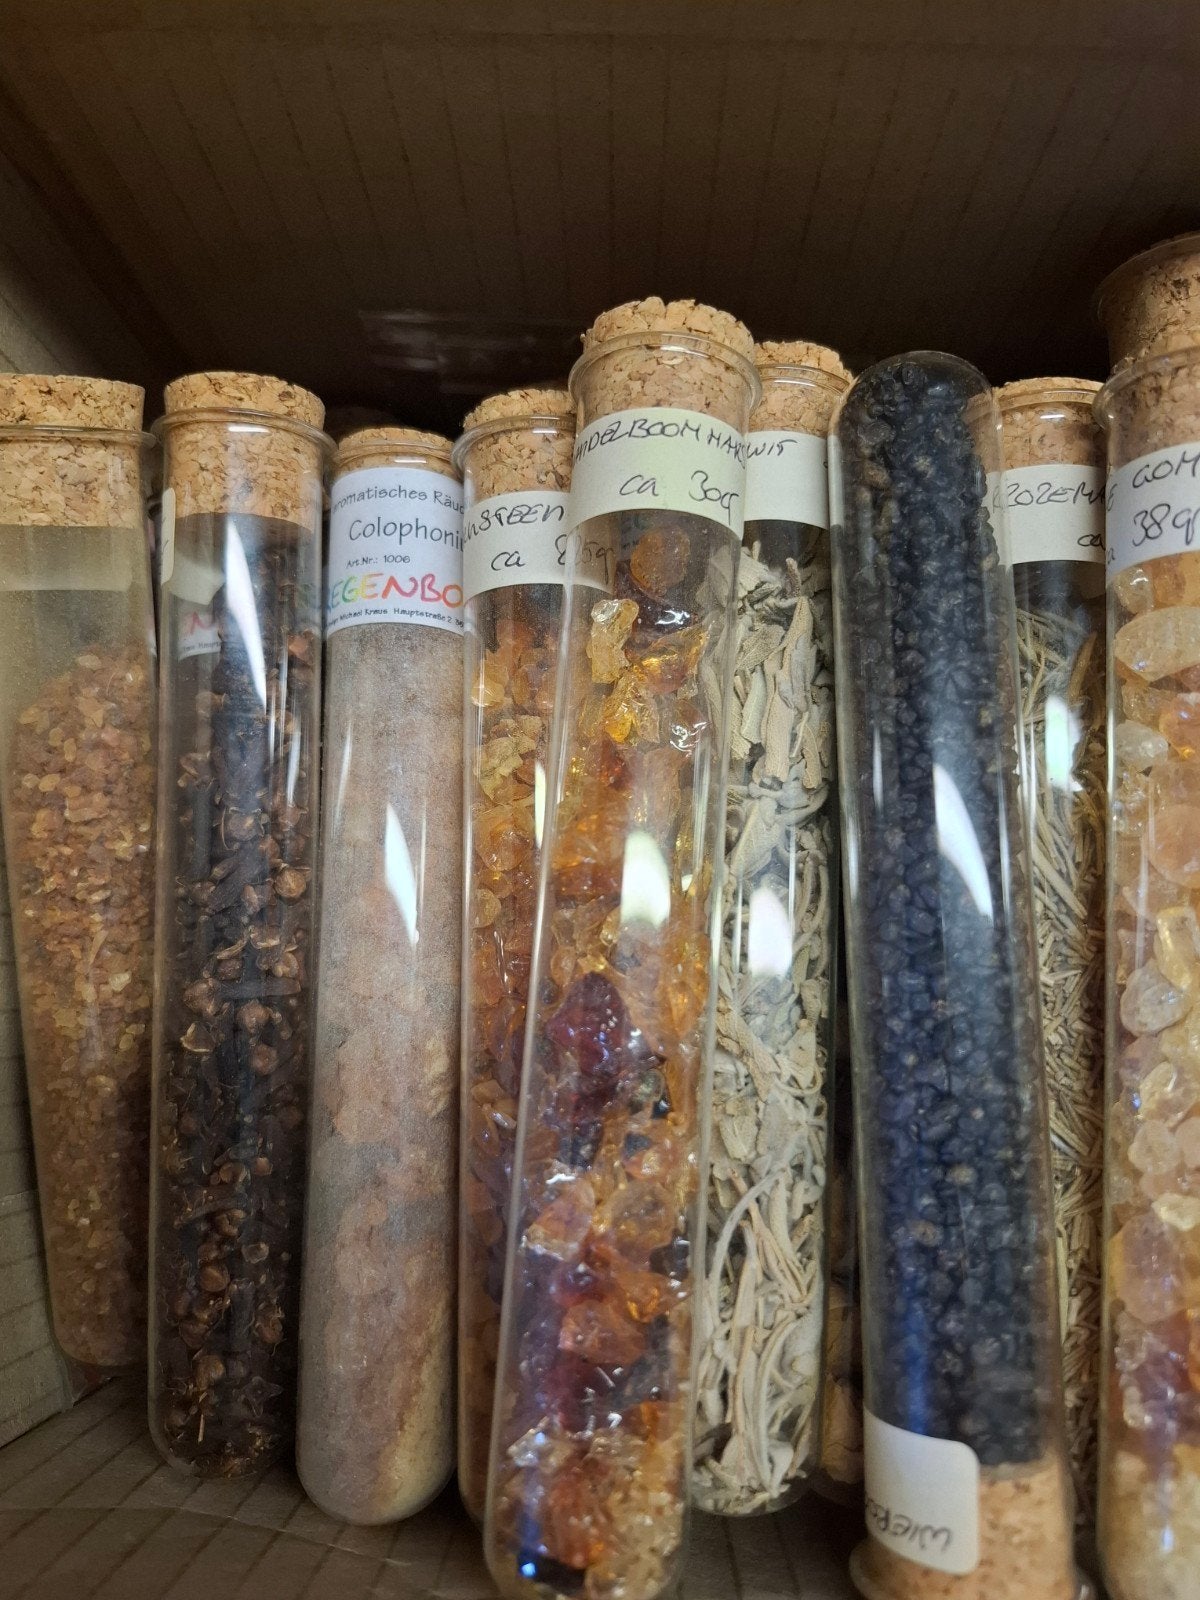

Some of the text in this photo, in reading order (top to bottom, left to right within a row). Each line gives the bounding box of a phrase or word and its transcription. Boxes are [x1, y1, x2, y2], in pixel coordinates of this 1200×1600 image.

[619, 474, 658, 497] ca
[383, 554, 411, 564] 1006
[490, 550, 526, 571] ca
[326, 572, 465, 613] EGENBO
